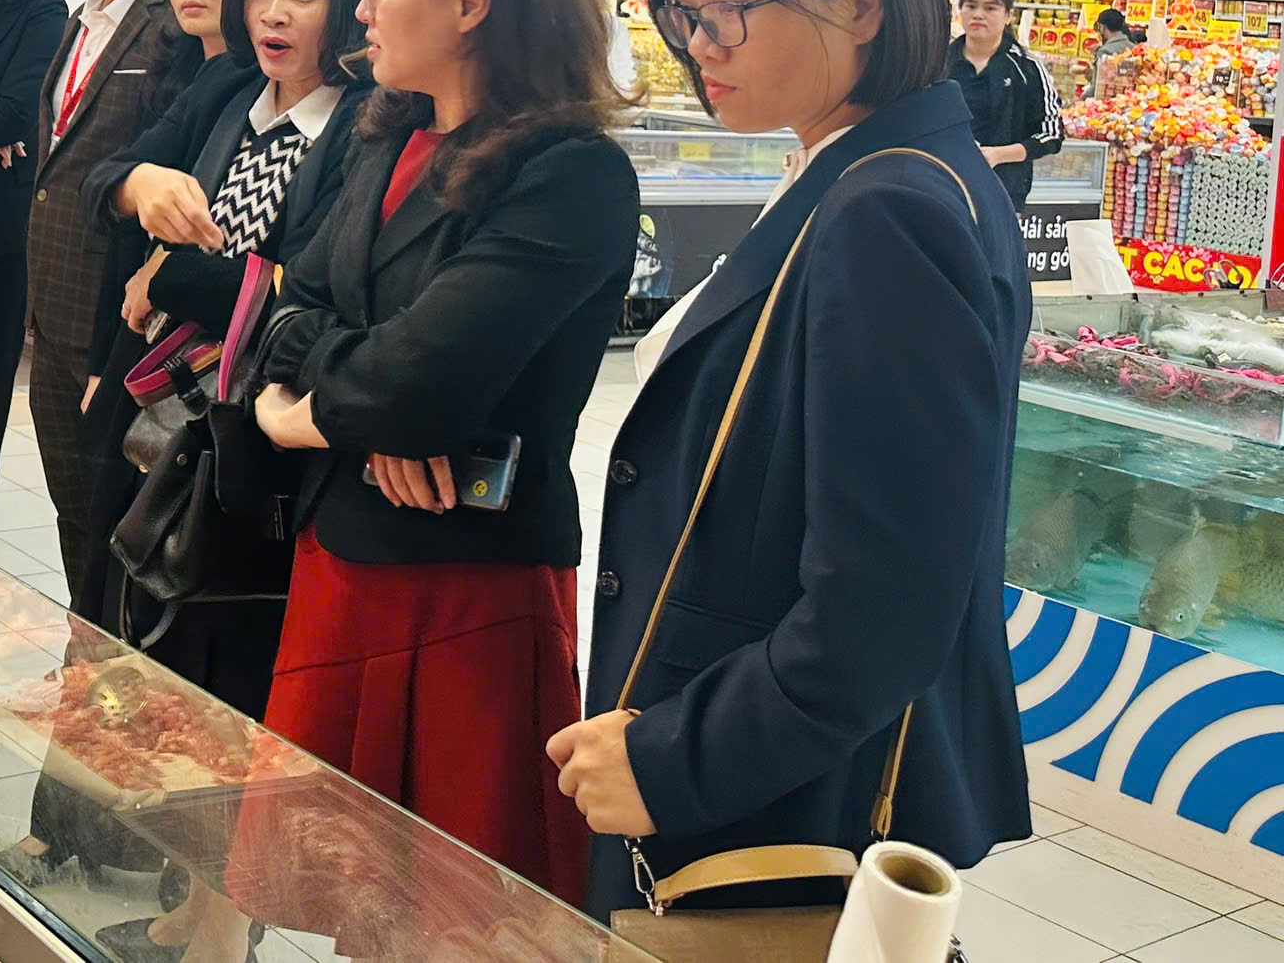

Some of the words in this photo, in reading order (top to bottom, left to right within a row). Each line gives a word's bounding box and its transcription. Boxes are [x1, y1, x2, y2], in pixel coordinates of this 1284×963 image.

[1027, 251, 1047, 272] ng
[1050, 246, 1070, 271] gó
[1143, 250, 1205, 282] CÁC
